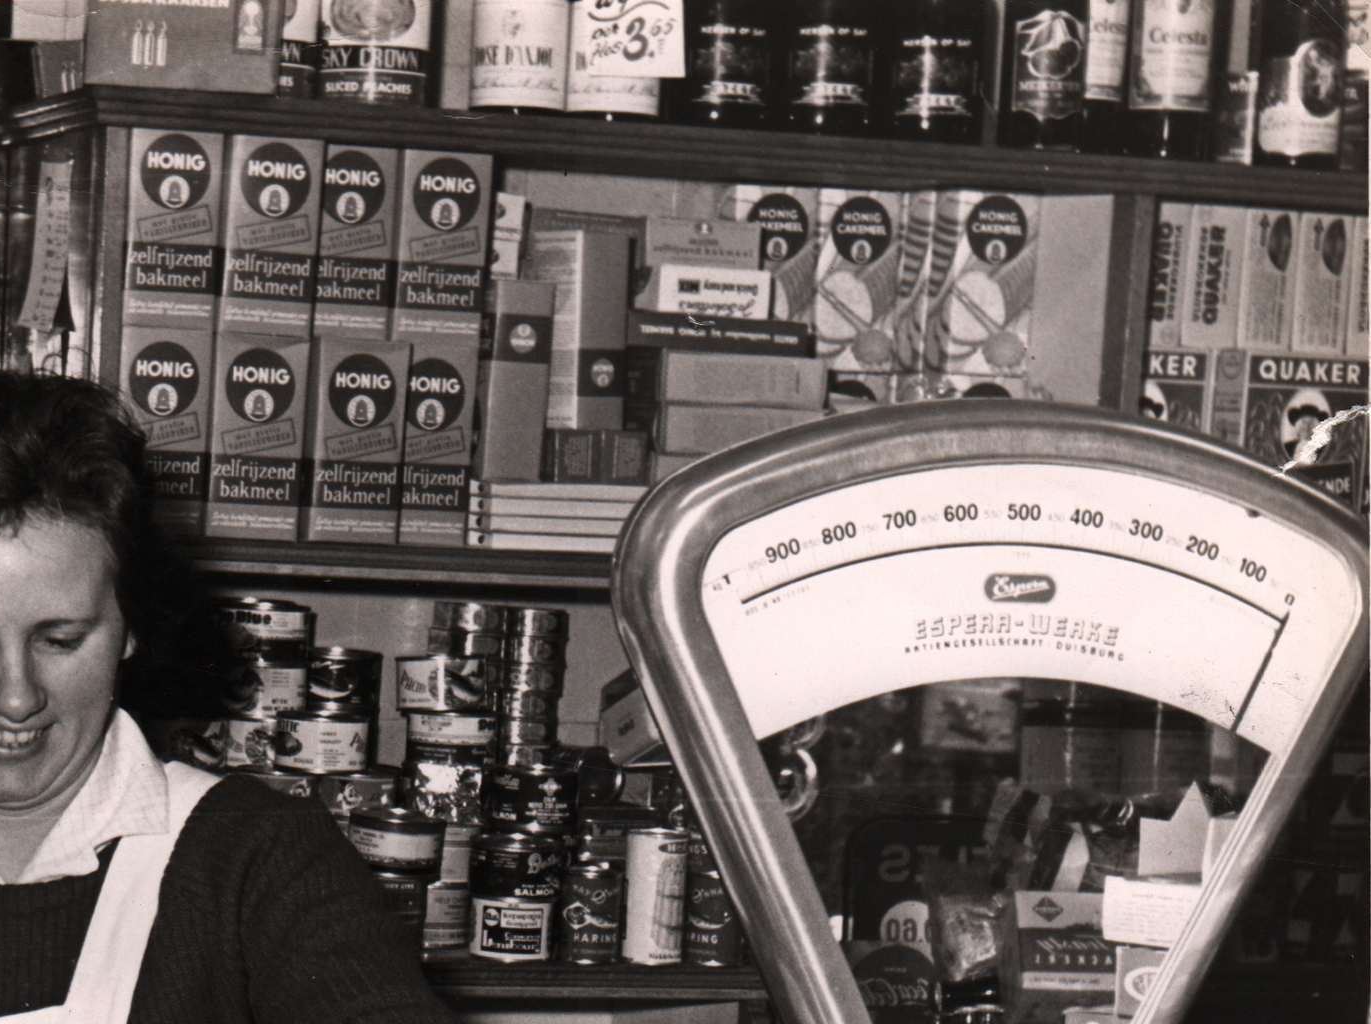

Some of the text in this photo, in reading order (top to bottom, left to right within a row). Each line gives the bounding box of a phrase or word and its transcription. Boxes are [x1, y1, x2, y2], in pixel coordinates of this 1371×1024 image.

[359, 47, 420, 71] CROWN
[325, 81, 359, 93] SLICED
[147, 150, 206, 172] HONIG
[248, 159, 307, 182] HONIG
[325, 167, 381, 188] HONIG
[420, 174, 477, 195] HONIG
[759, 208, 799, 220] HONIG
[843, 211, 882, 224] HONIG
[978, 210, 1017, 223] HONIG
[130, 246, 213, 270] zelfrijzend
[229, 253, 311, 278] zelfrijzend
[136, 266, 206, 288] bakmeel
[233, 273, 305, 297] bakmeel
[400, 261, 480, 288] zelfrijzend
[1201, 223, 1227, 326] QUAKER
[406, 290, 475, 307] bakmeel
[136, 359, 195, 379] HONIG
[232, 365, 290, 385] HONIG
[1149, 355, 1198, 377] KER
[1258, 358, 1361, 384] QUAKER
[335, 372, 391, 390] HONIG
[213, 458, 296, 482] zelfrijzend
[316, 464, 397, 487] zelfrijzend
[220, 479, 290, 500] bakmeel
[324, 485, 391, 506] bakmeel
[765, 503, 1296, 606] 900 800 700 600 500 400 300 200 100 0
[990, 576, 1051, 601] Espera
[915, 613, 1121, 648] ESPERA-WERKE
[904, 638, 1125, 662] AKTIENGESELLSCHAFT DUISBURG
[514, 888, 555, 897] SALMON
